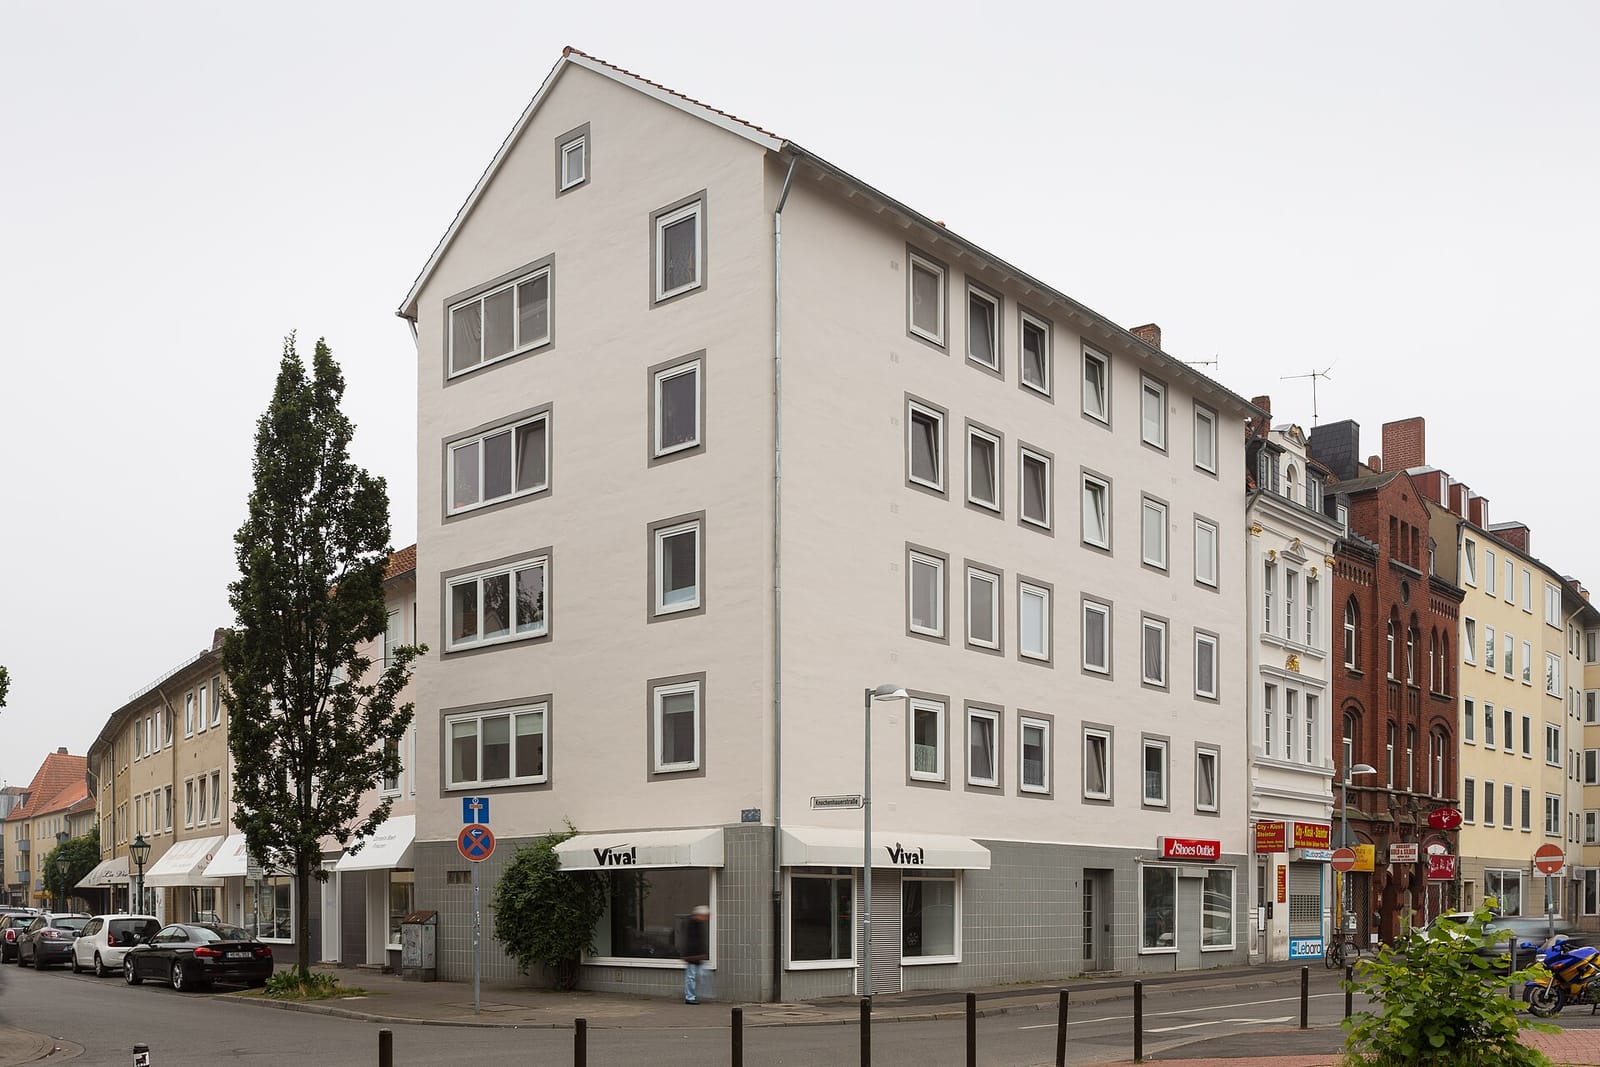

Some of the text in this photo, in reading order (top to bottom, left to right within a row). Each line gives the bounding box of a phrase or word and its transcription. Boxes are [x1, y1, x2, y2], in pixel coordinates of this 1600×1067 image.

[815, 798, 858, 806] Knochenhauerstraße
[1304, 826, 1314, 837] Kiosk
[593, 846, 637, 866] Viva!
[883, 844, 924, 865] Viva!
[1175, 843, 1215, 857] Shoes Outlet
